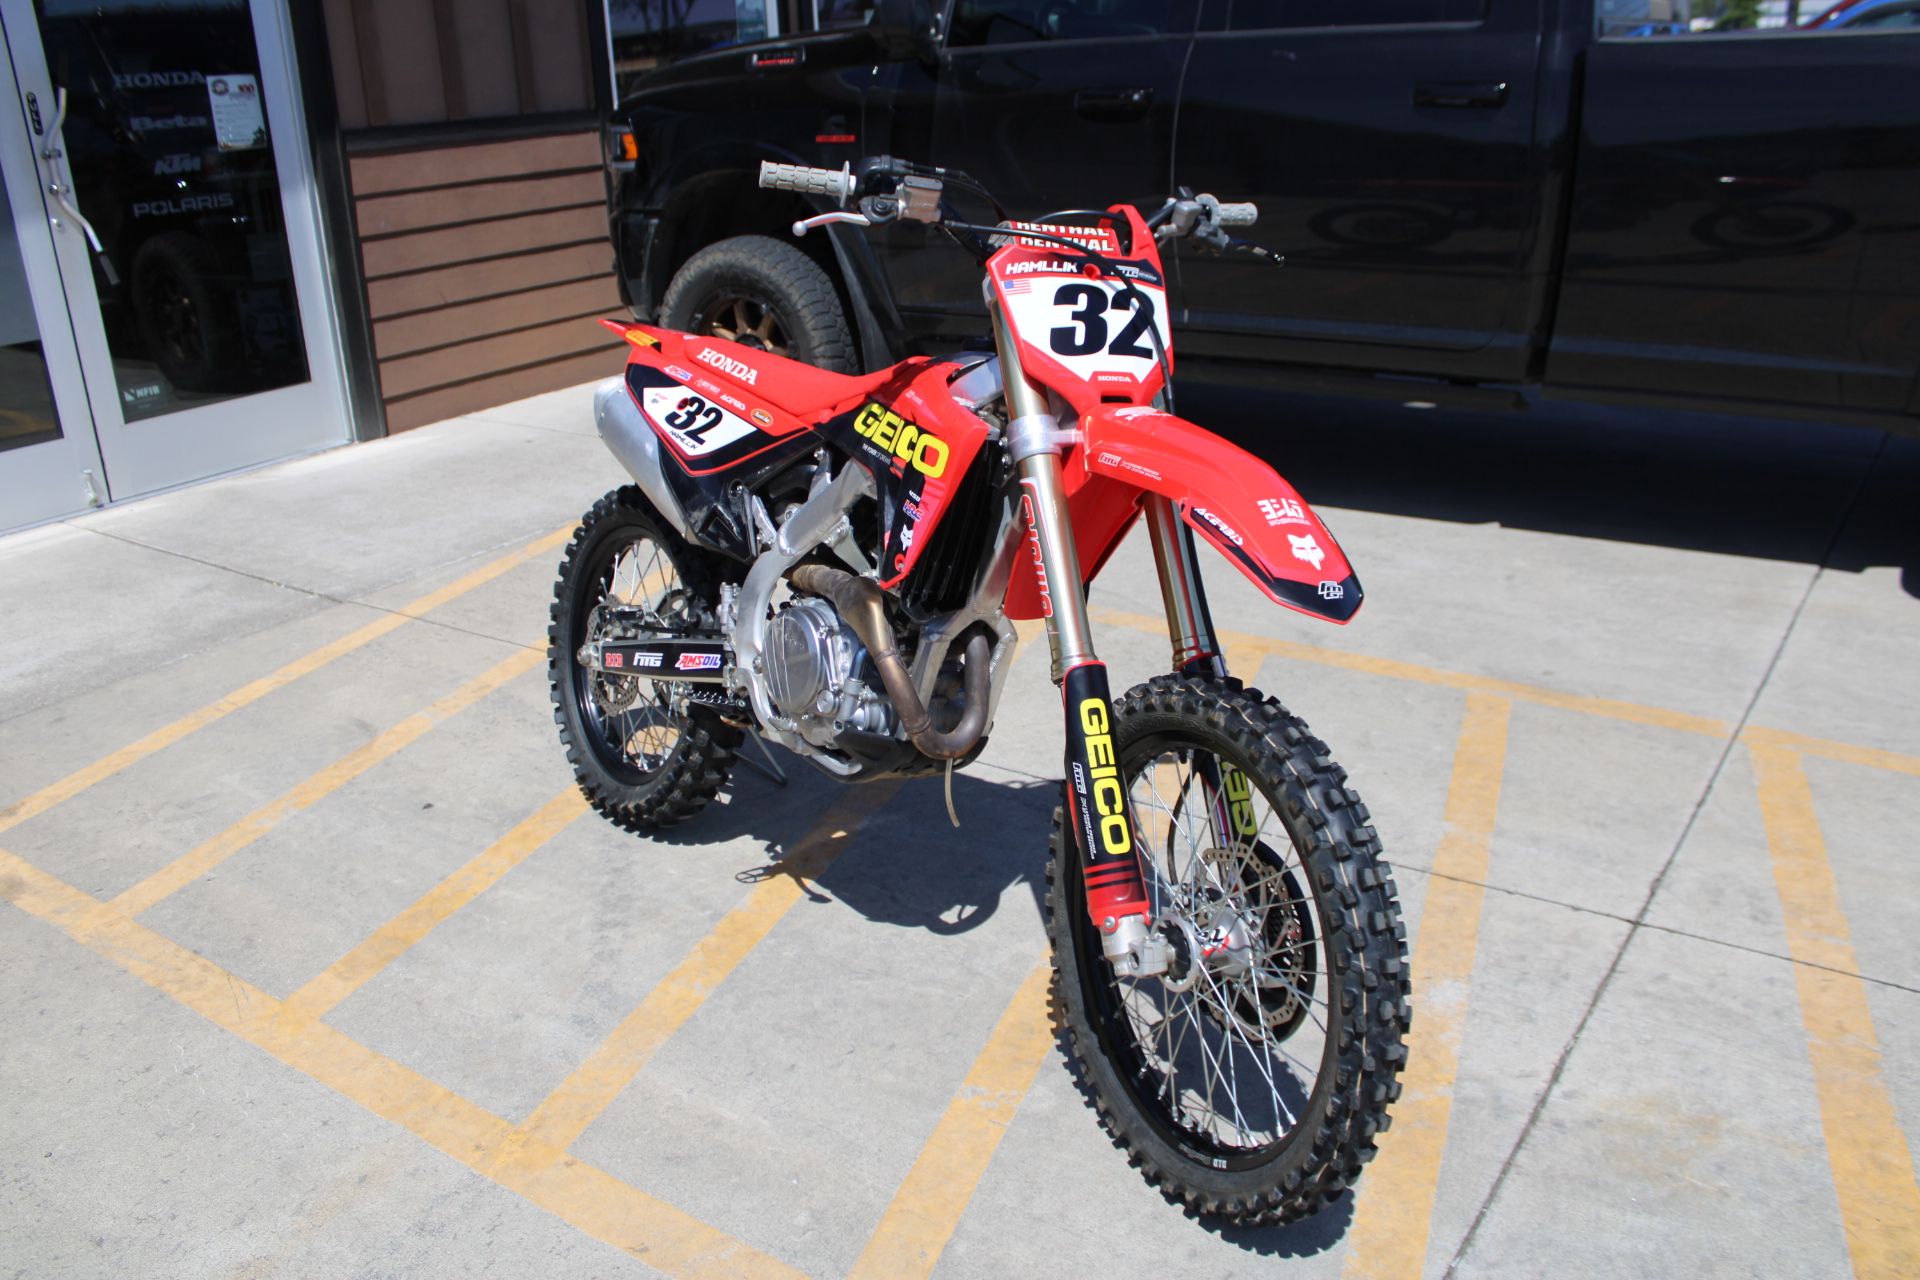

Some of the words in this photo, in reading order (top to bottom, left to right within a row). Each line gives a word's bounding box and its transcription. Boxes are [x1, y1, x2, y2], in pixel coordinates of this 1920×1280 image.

[113, 70, 208, 88] HONDA
[129, 113, 208, 131] Beta
[153, 154, 201, 176] KTM
[132, 192, 234, 218] POLARIS
[1005, 260, 1078, 274] HAMLLIK
[1050, 283, 1155, 360] 32
[696, 347, 758, 386] HONDA
[1097, 375, 1132, 383] HONDA
[664, 395, 724, 446] 32
[853, 402, 950, 479] GEICO
[675, 652, 722, 670] AMSOIL
[1079, 697, 1131, 855] GEICO
